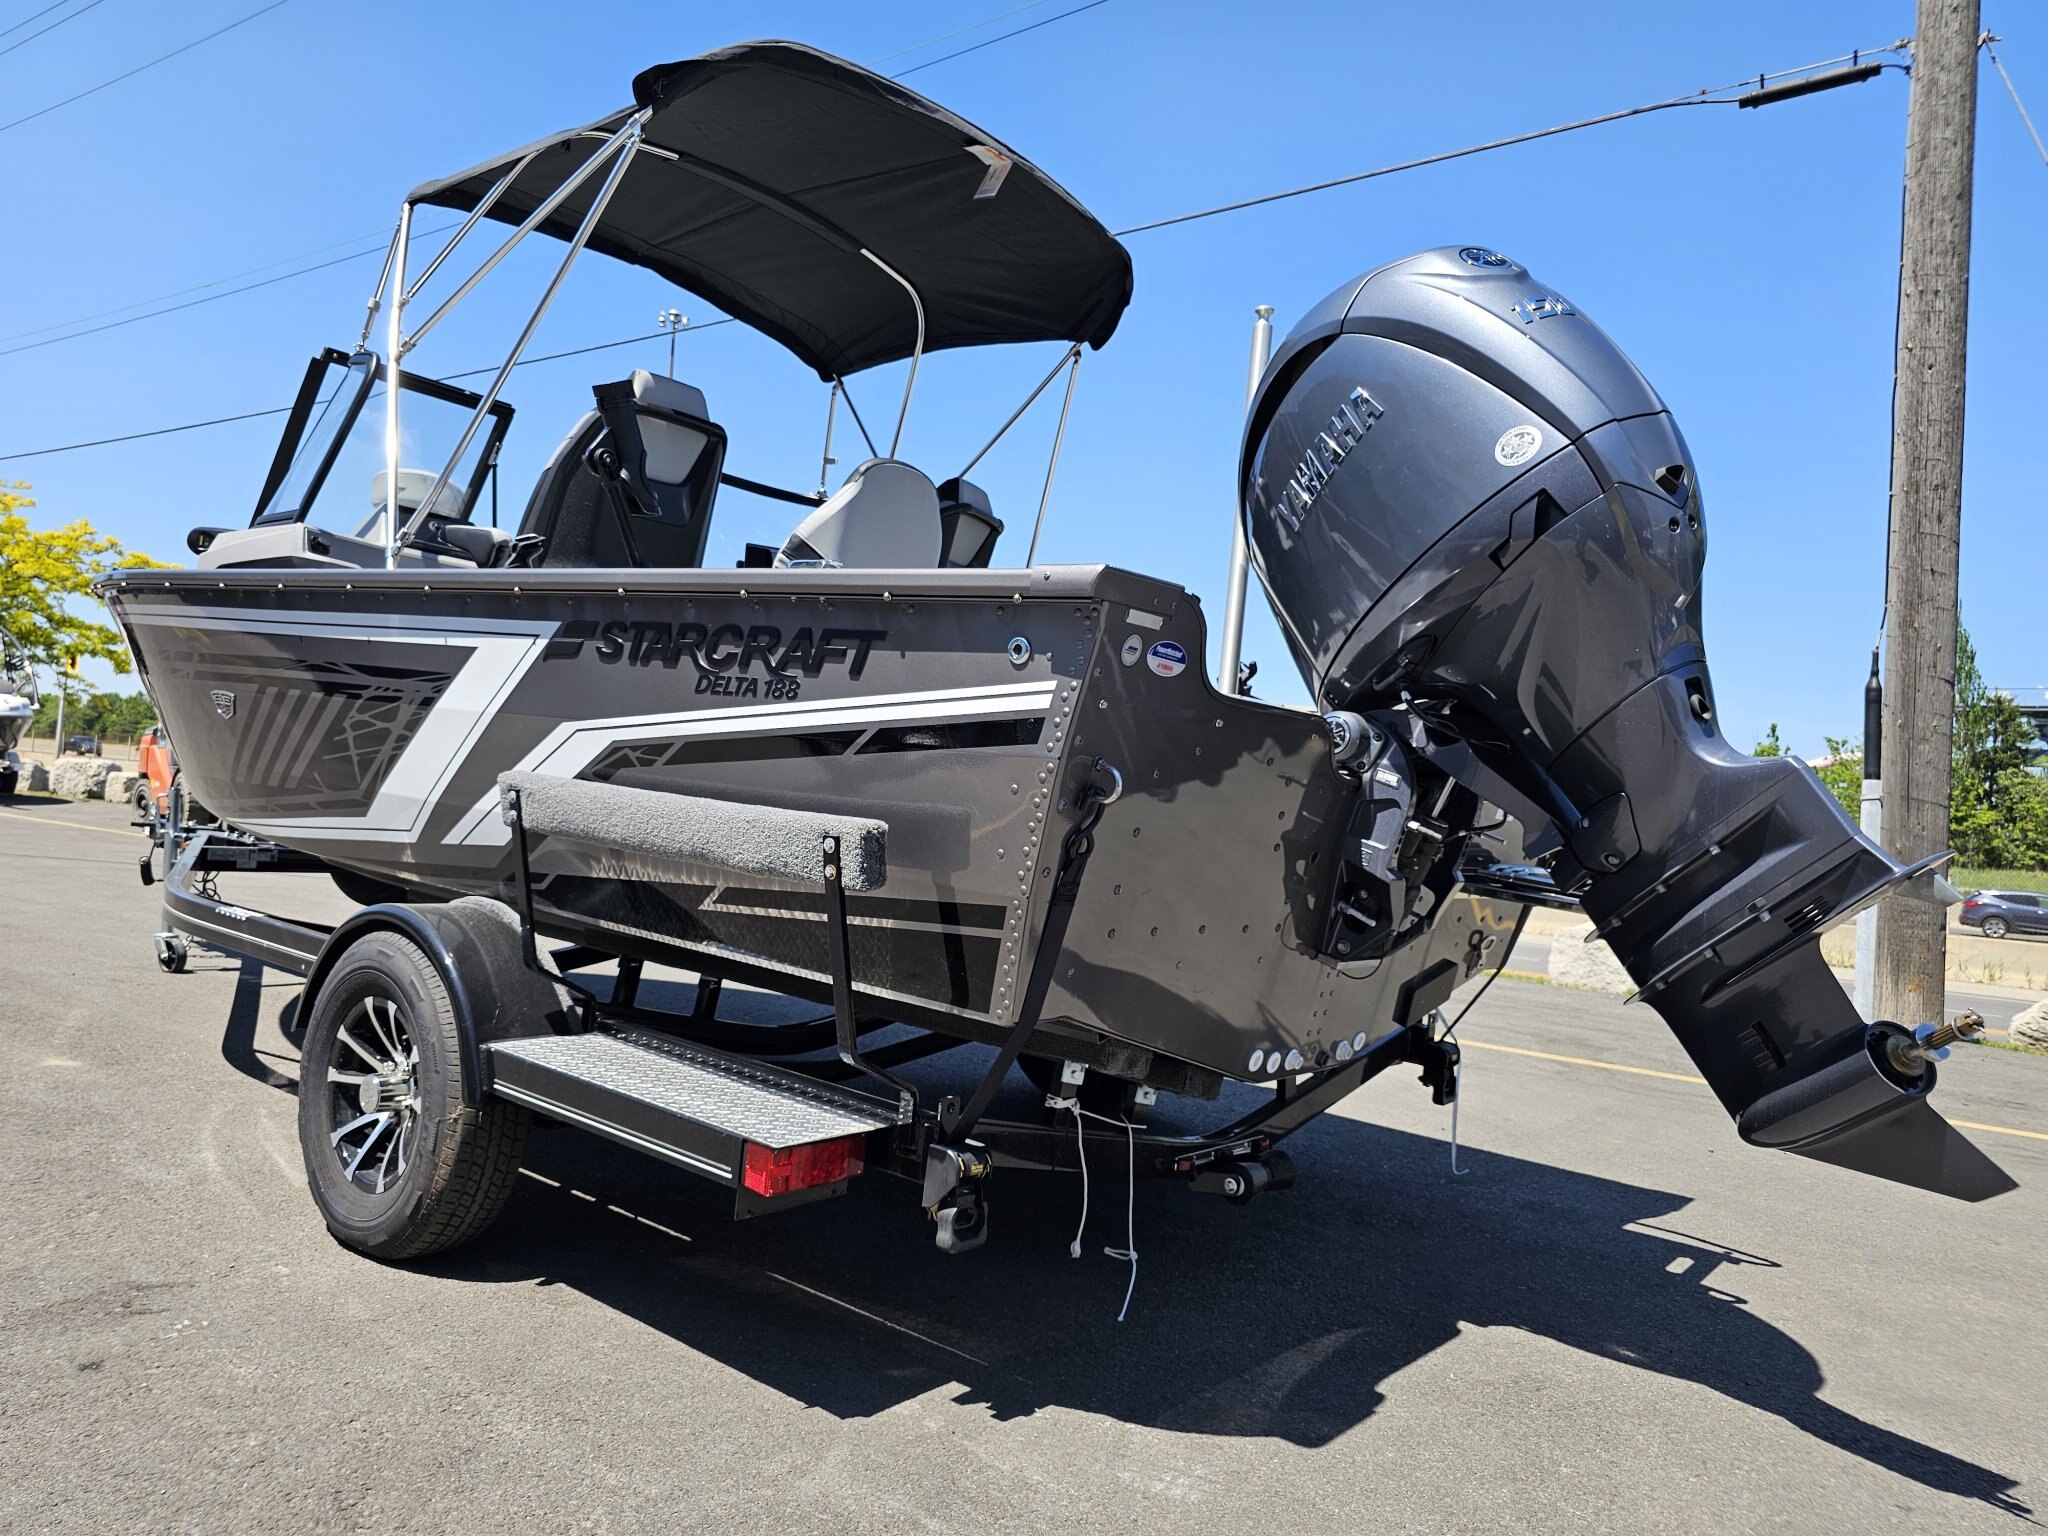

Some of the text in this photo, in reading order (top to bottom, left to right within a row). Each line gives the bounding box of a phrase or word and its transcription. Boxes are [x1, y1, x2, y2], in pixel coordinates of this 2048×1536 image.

[1277, 386, 1385, 532] YAMAHA
[596, 620, 888, 681] STARCRAFT
[695, 675, 801, 701] DELTA 188
